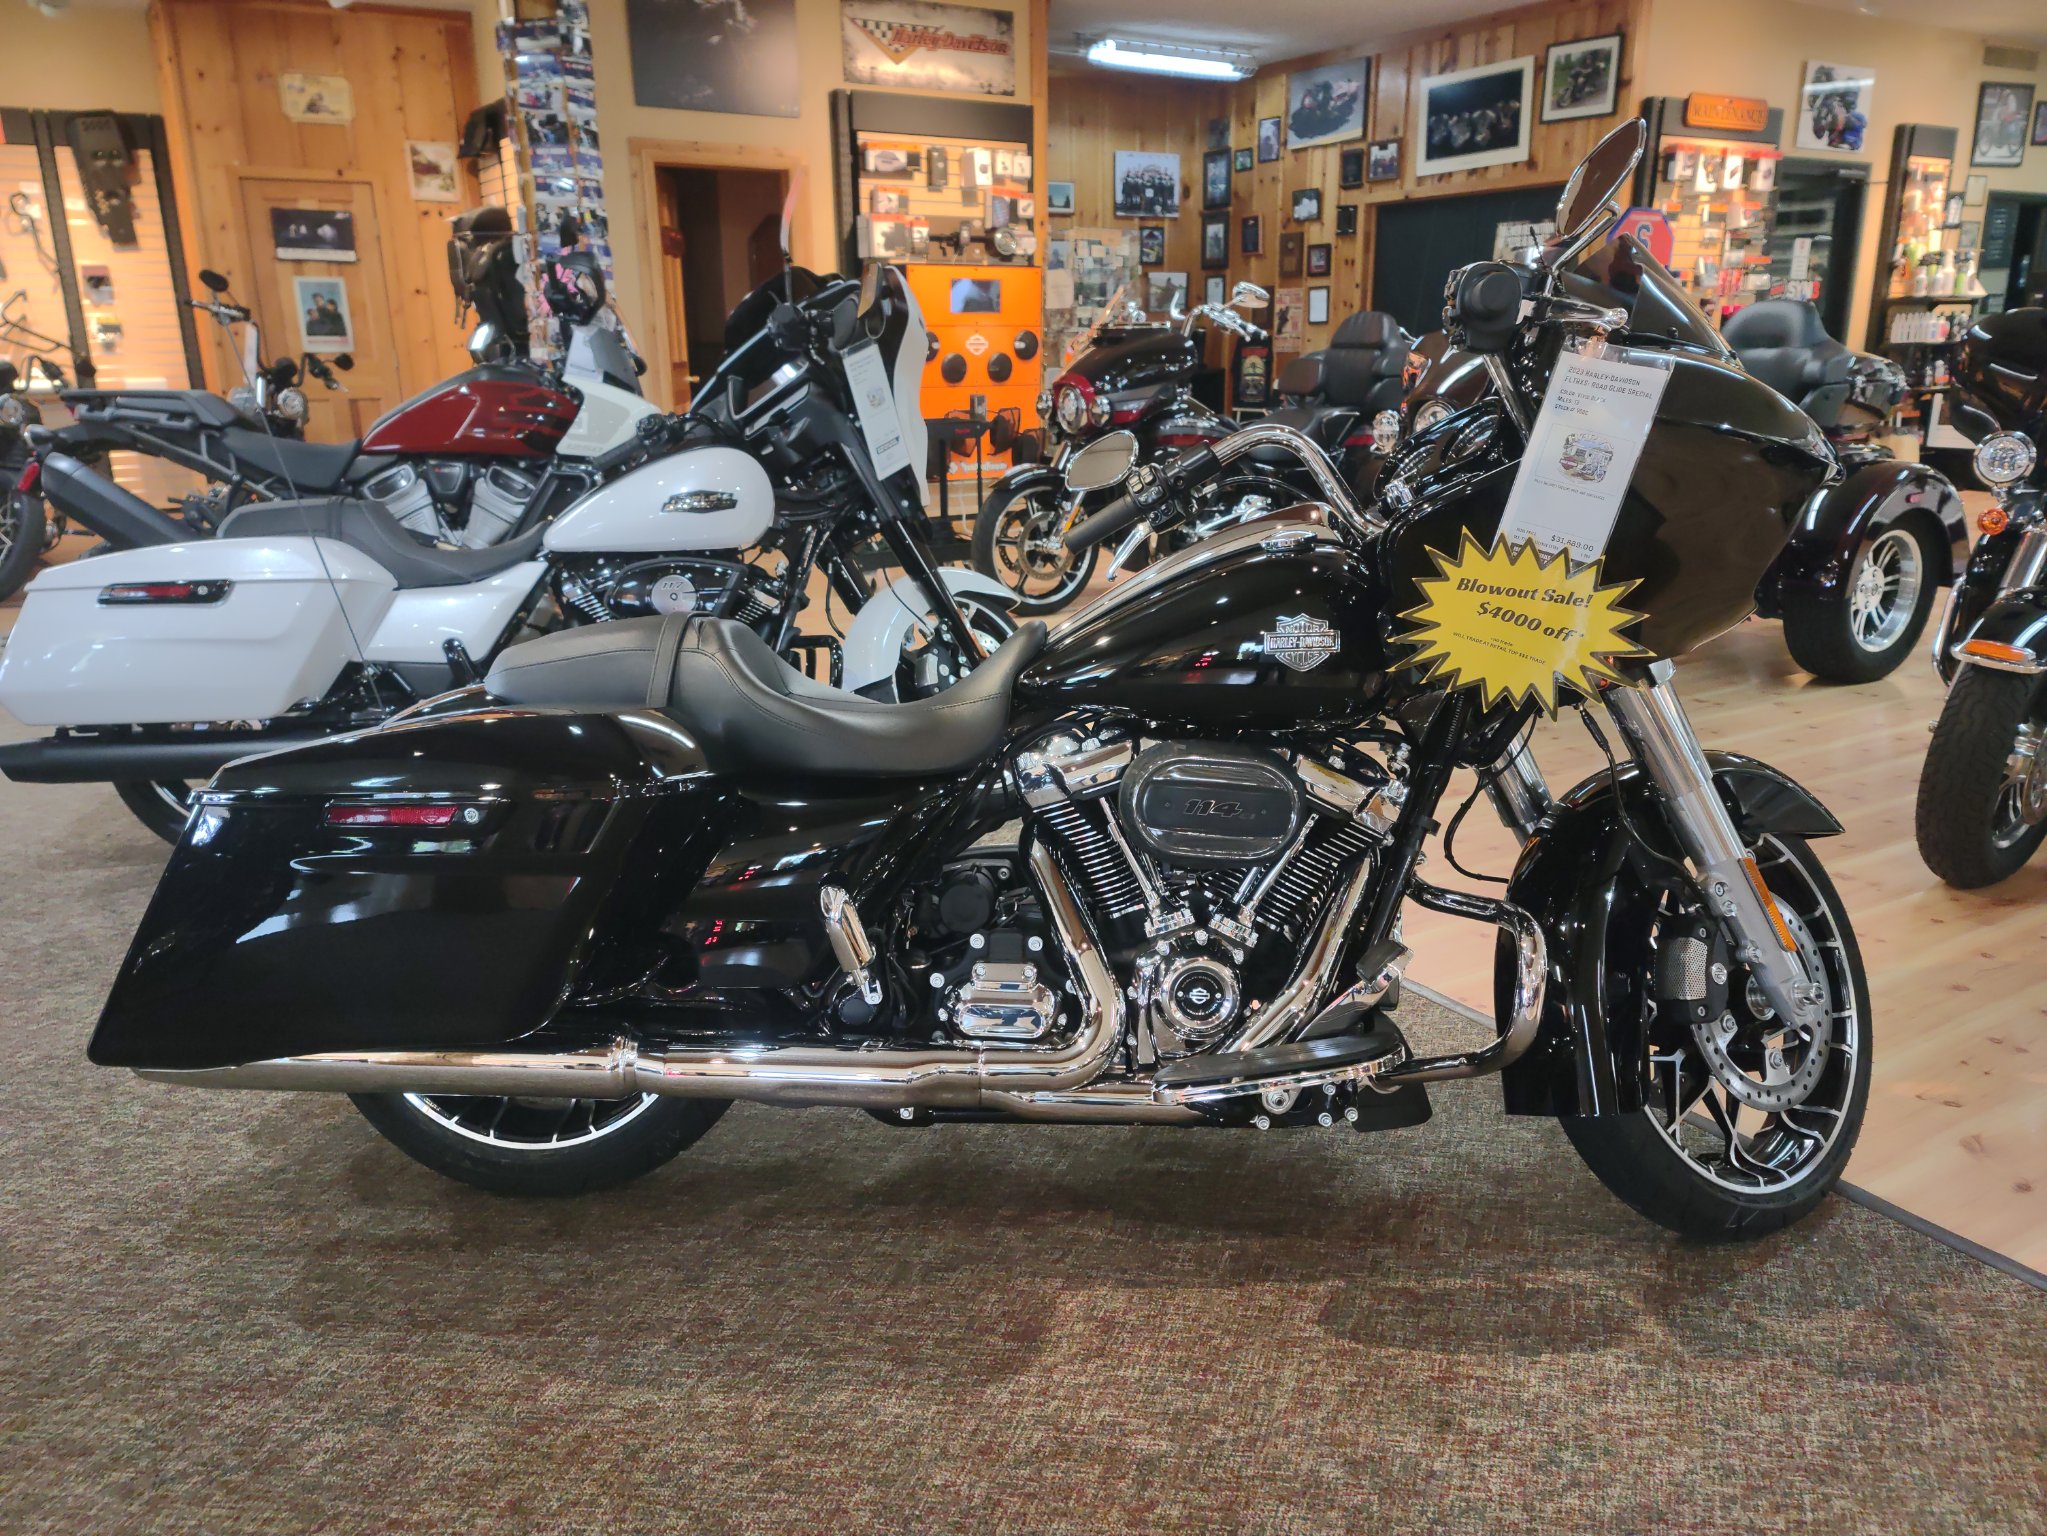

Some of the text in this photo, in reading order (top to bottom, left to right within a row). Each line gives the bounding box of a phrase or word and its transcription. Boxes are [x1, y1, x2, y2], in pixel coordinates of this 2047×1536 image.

[1568, 366, 1641, 386] 2023 HARLEY-DAVIDSON
[1591, 382, 1608, 391] ROAD
[1609, 384, 1627, 394] GLIDE
[1628, 389, 1653, 399] SPECIAL
[1456, 577, 1594, 608] Blowout Sale!
[1477, 601, 1542, 631] $4000
[1285, 621, 1321, 633] MOTOR
[1270, 636, 1335, 649] HARLEY-DAVIDSON
[1466, 635, 1483, 645] TRADE
[1529, 655, 1546, 665] TRADE
[1285, 651, 1320, 663] CYCLES
[1183, 799, 1243, 818] 114
